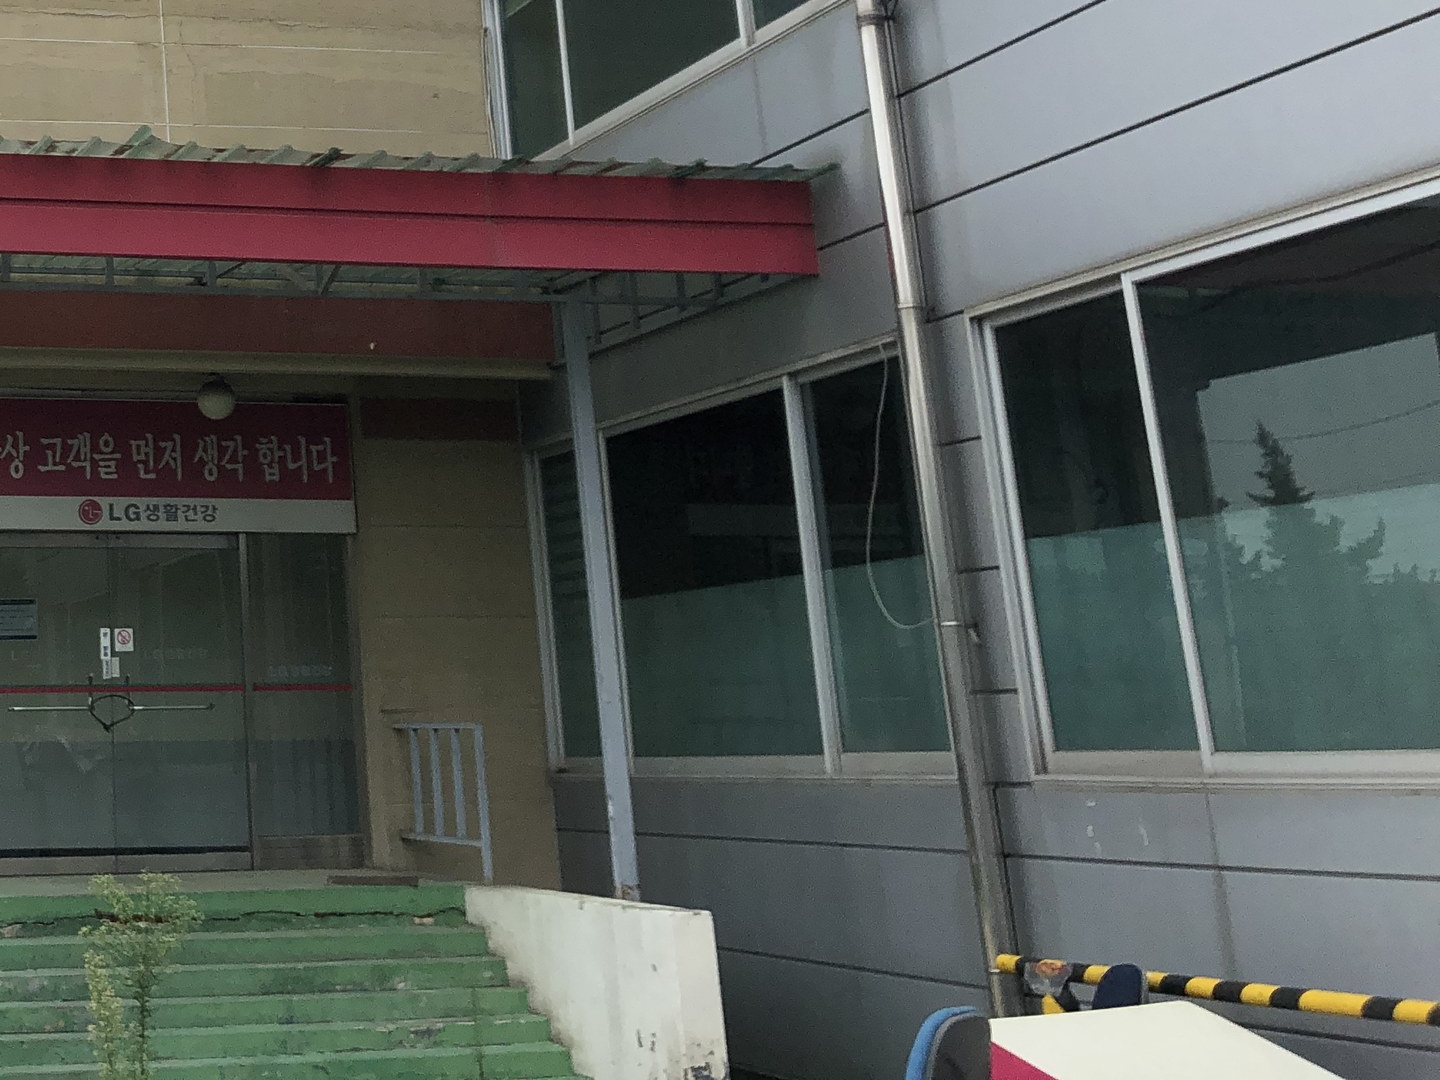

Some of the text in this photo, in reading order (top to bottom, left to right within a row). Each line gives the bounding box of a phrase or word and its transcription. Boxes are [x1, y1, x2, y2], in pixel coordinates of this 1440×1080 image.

[37, 431, 122, 481] 고객을
[129, 432, 182, 483] 먼저
[193, 433, 250, 483] 생각
[255, 434, 339, 484] 합니다
